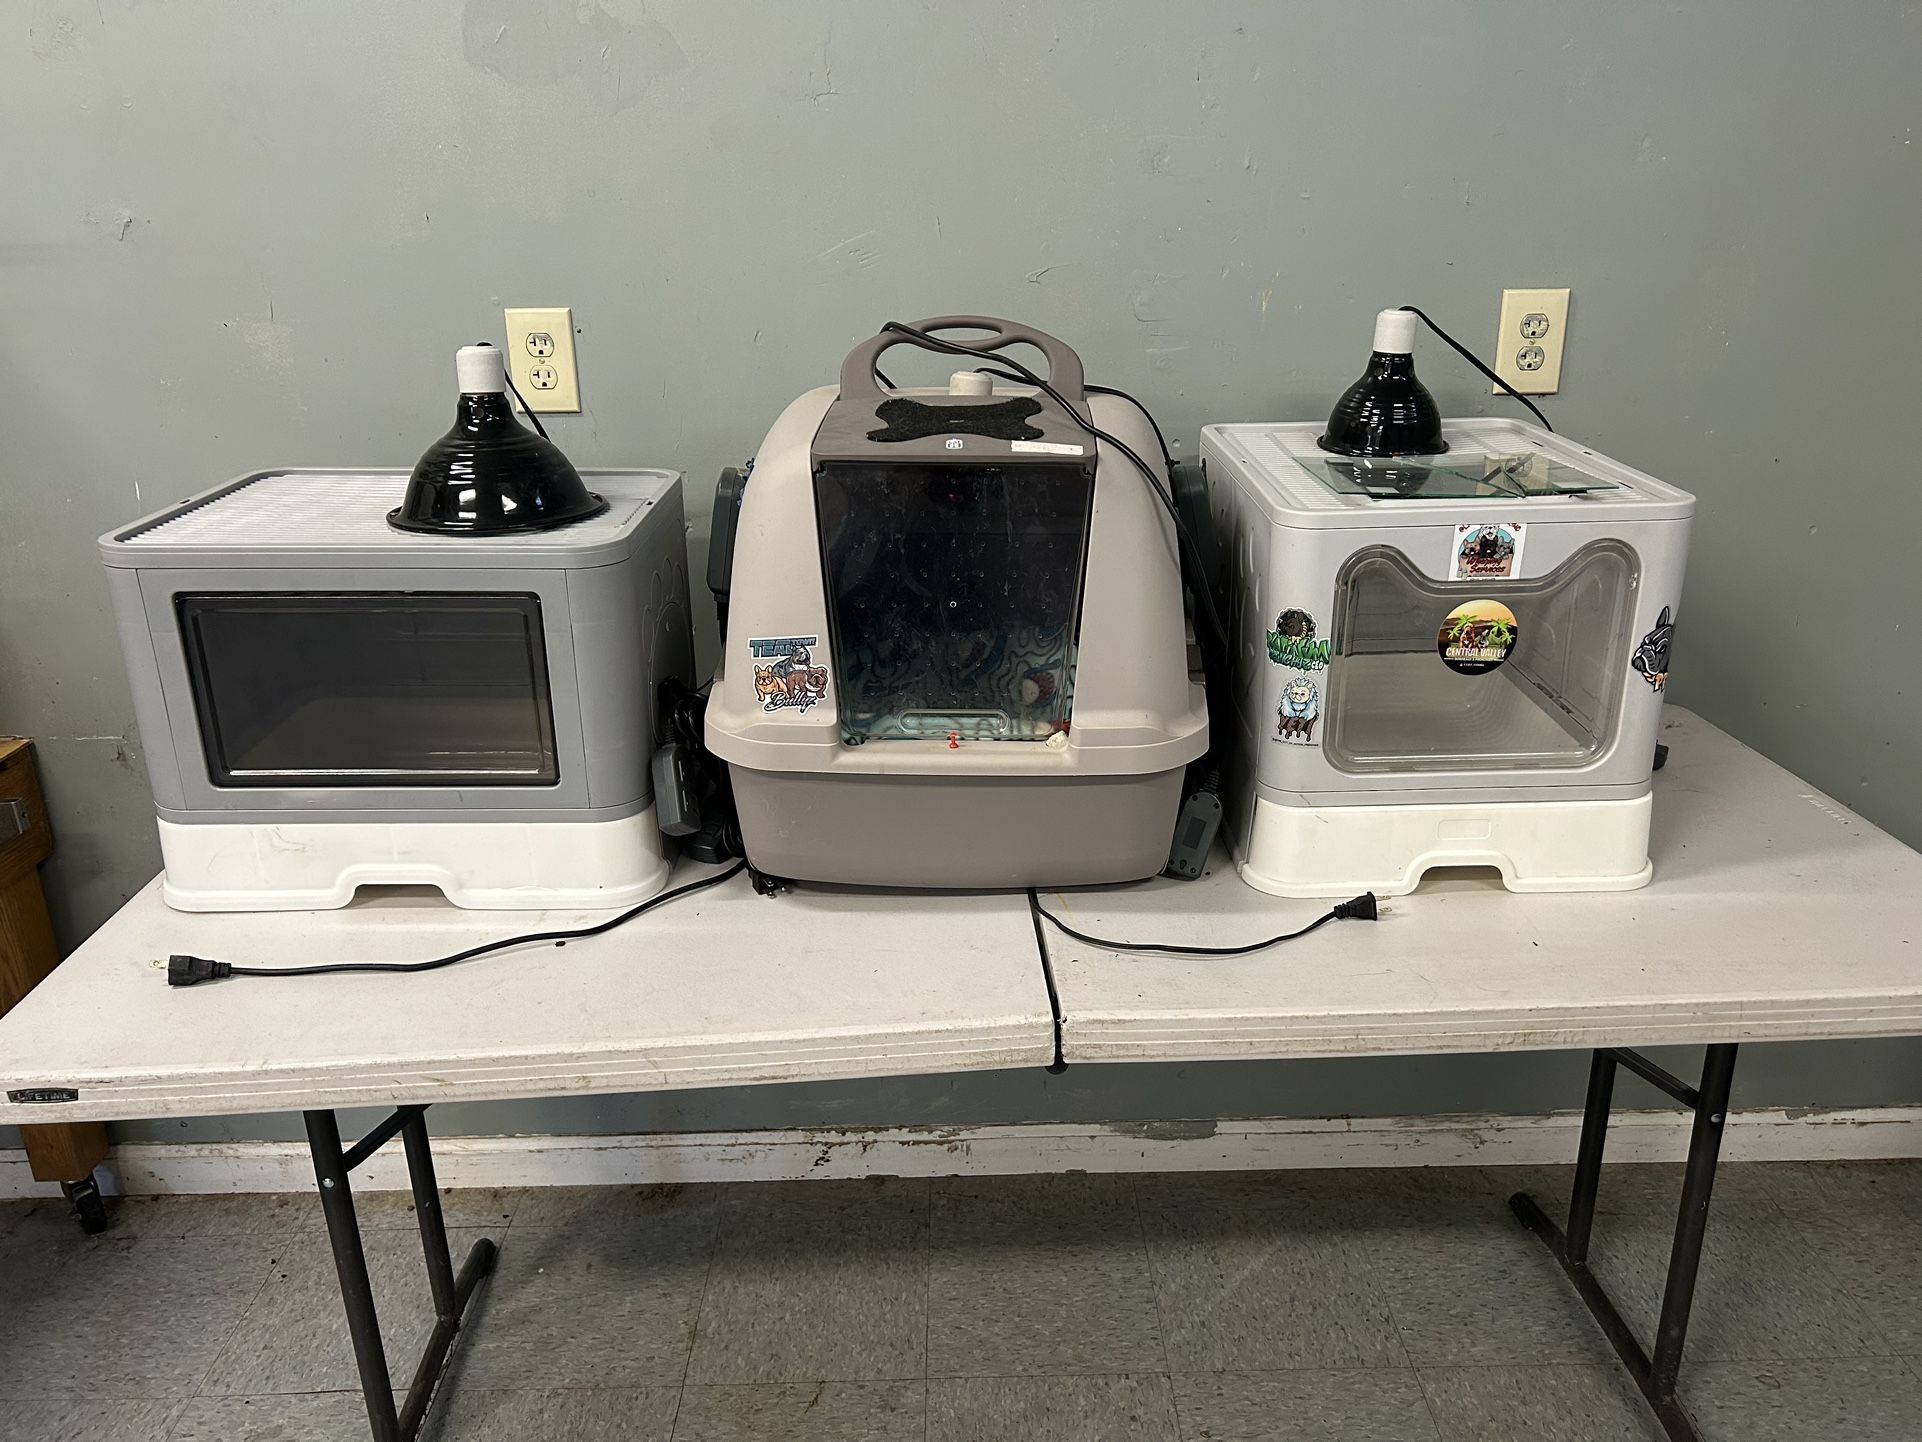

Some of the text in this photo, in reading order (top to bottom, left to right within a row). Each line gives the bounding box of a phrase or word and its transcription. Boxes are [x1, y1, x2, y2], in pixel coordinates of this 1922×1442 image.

[1469, 564, 1506, 574] Services
[751, 640, 793, 657] TEAL
[1446, 647, 1507, 658] CENTRAL VALLEY
[1311, 660, 1324, 670] CEO
[764, 691, 817, 714] Bullyz
[16, 1092, 71, 1101] LIFETIME
